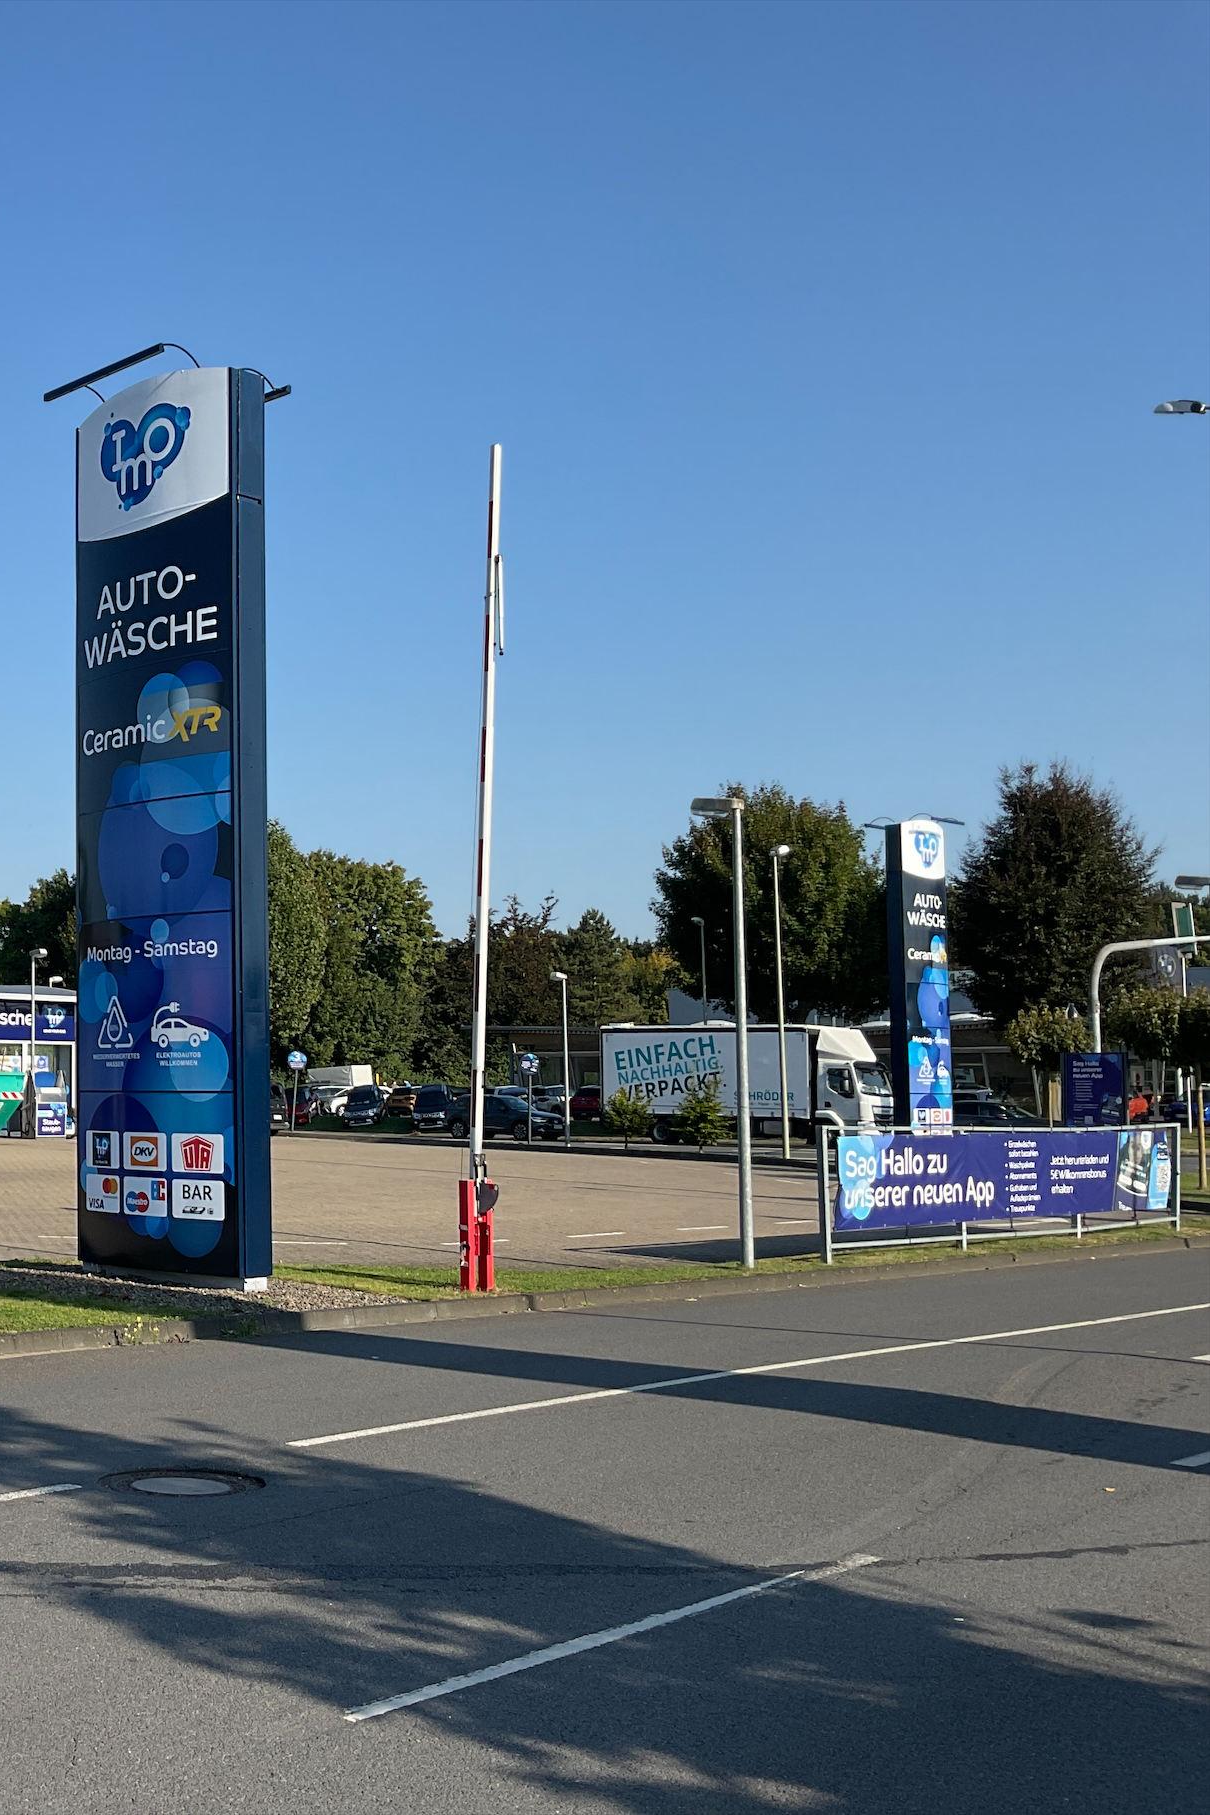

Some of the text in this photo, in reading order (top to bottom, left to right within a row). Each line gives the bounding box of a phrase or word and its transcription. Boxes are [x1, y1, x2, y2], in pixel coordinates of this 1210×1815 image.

[96, 565, 196, 620] AUTO-
[84, 606, 218, 669] WÄSCHE
[82, 705, 223, 756] Ceramic XTR
[913, 893, 943, 909] AUTO-
[907, 910, 946, 929] WÄSCHE
[86, 945, 132, 963] Montag
[143, 939, 218, 958] Samstag
[155, 1051, 202, 1059] ELEKTROAUTOS
[614, 1035, 721, 1070] EINFACH.
[617, 1056, 724, 1085] NACHHALTIG.
[734, 1089, 794, 1101] SHRÖDR
[134, 1146, 155, 1157] DKV
[182, 1136, 212, 1169] UTA
[1050, 1155, 1064, 1165] Jetzt
[1099, 1154, 1109, 1164] und
[845, 1147, 948, 1184] Sag Hallo zu
[182, 1184, 213, 1201] BAR
[844, 1175, 995, 1209] unserer neuen App
[1050, 1184, 1074, 1194] erhalten
[89, 1198, 105, 1210] VISA
[126, 1197, 149, 1206] Maestro
